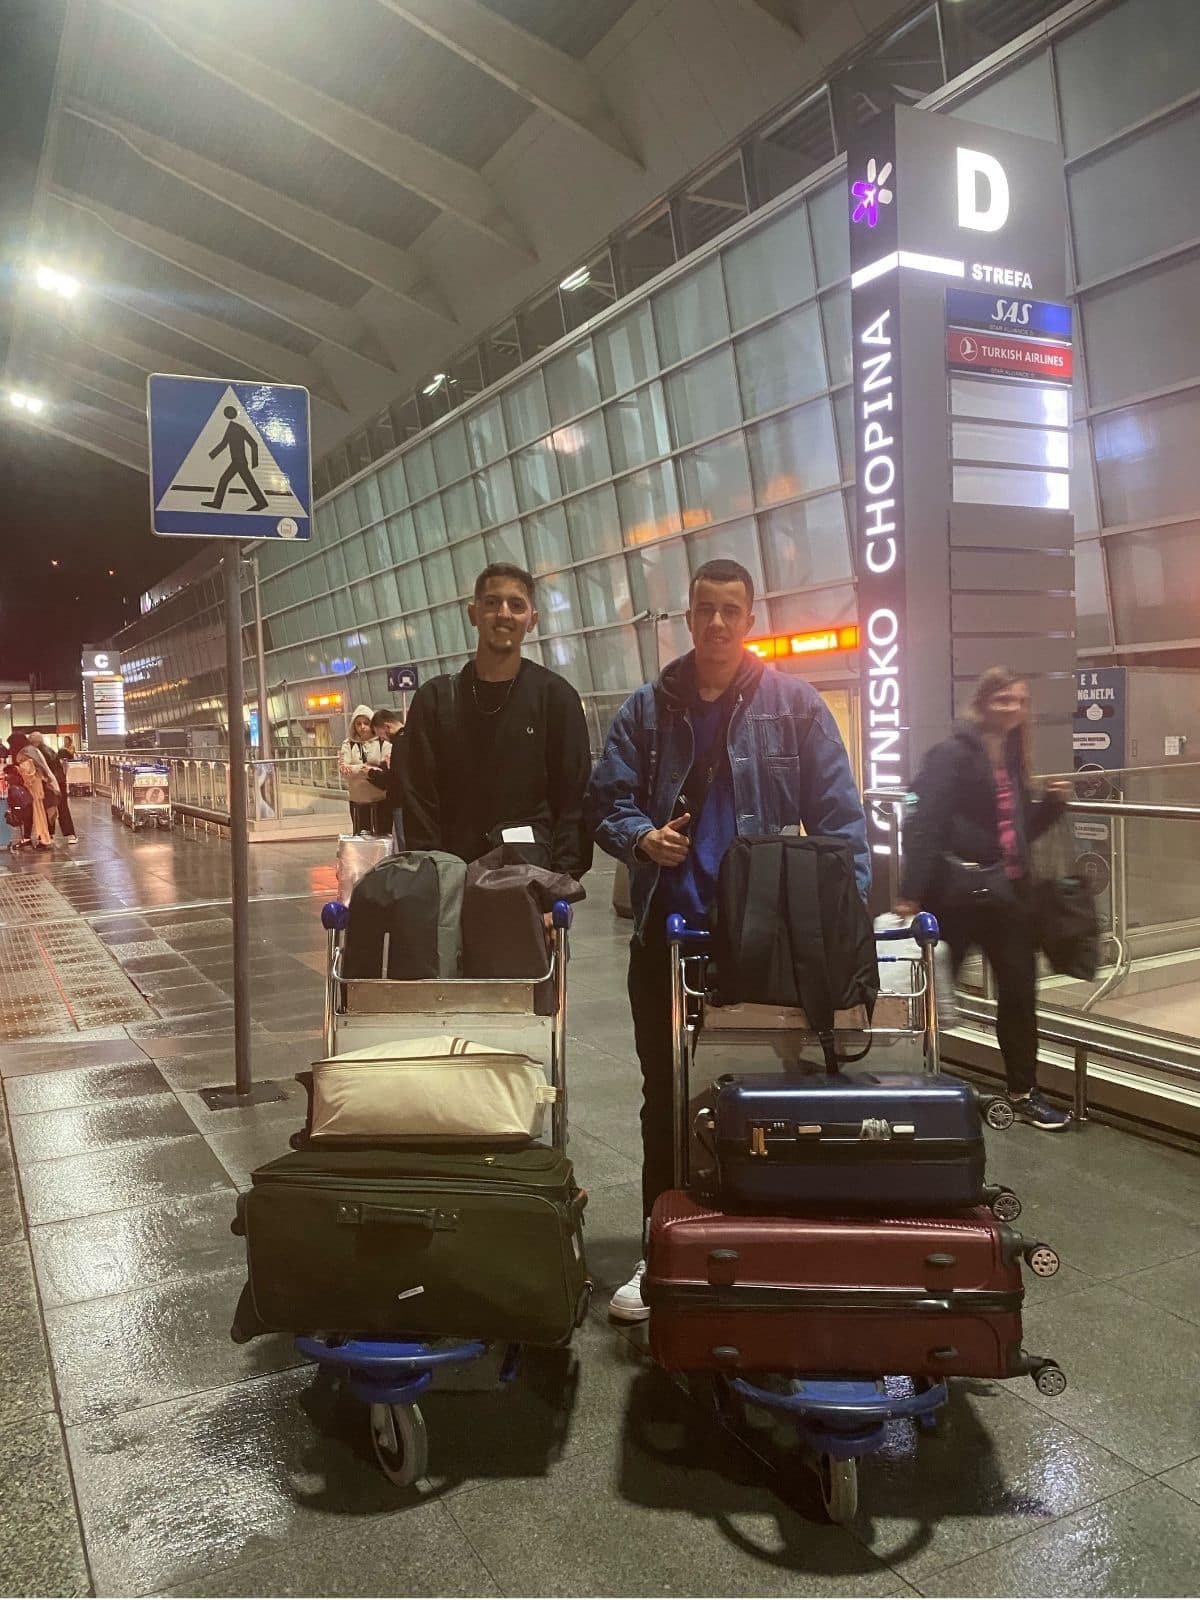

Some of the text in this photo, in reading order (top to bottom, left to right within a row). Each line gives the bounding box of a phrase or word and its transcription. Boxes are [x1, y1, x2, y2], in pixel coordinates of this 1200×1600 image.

[957, 147, 1010, 232] D
[972, 263, 1033, 290] STREFA
[991, 299, 1033, 324] SAS
[981, 345, 1064, 367] TURKISH AIRLINES
[861, 309, 897, 573] CHOPINA
[94, 653, 110, 669] C
[1077, 687, 1115, 701] NG.NET.PL
